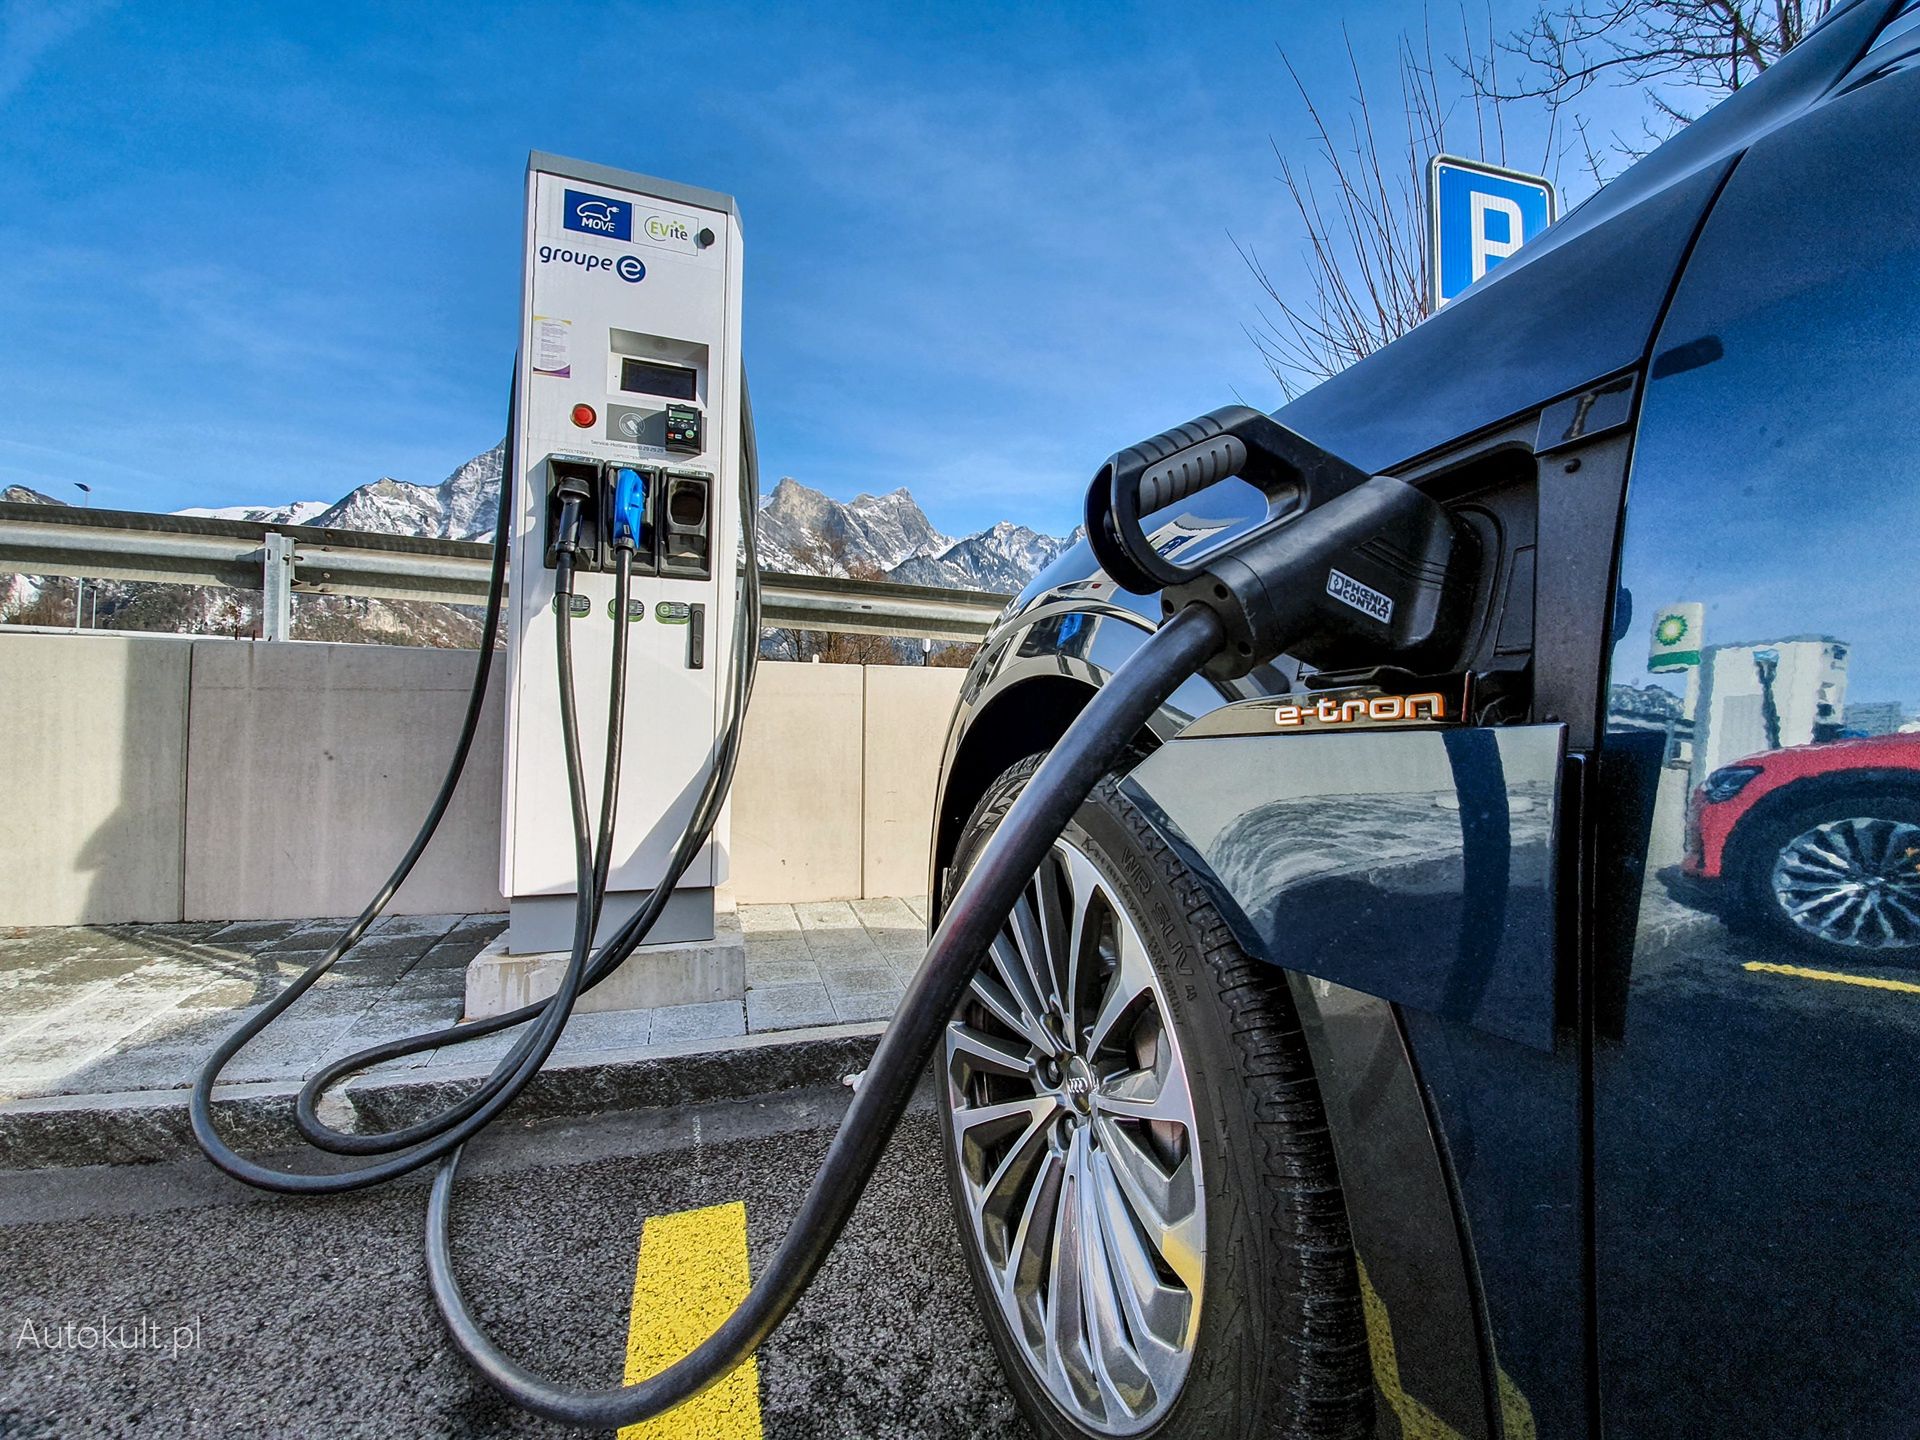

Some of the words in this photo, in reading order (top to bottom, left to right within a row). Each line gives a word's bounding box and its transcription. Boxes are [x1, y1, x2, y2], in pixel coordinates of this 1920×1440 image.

[581, 217, 616, 233] MOVE
[650, 220, 688, 241] EVite
[1470, 191, 1523, 283] P
[539, 246, 613, 271] groupe
[1342, 589, 1390, 619] CONTACT
[1275, 692, 1446, 726] e-tron
[1121, 847, 1152, 899] WR
